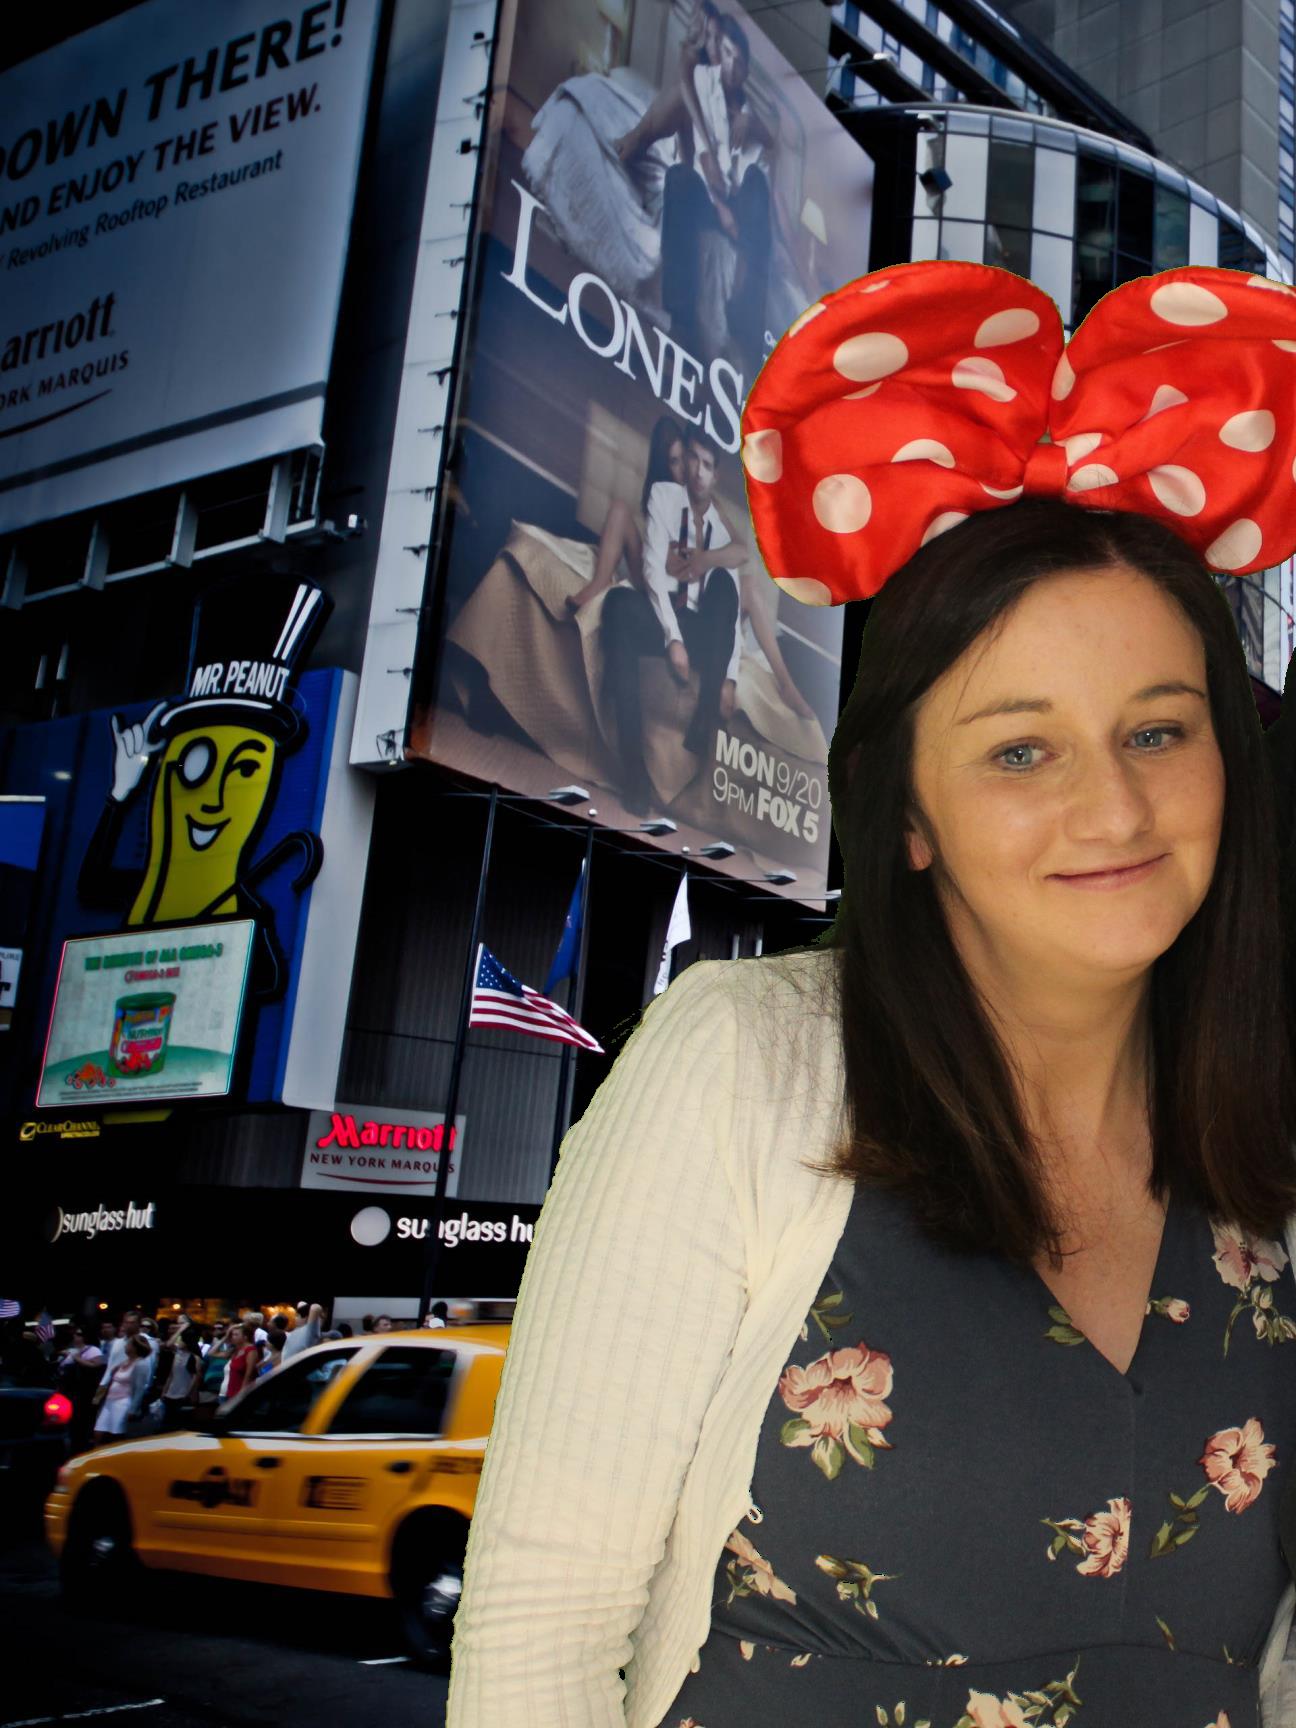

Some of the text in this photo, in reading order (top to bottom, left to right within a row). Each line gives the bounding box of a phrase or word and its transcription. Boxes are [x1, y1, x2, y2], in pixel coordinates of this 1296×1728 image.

[0, 0, 347, 182] OWN THERE!
[48, 150, 145, 216] ENJOY
[154, 122, 218, 172] THE
[229, 83, 322, 143] VIEW.
[8, 150, 283, 270] Revolving Rooftop Restaurant
[38, 350, 129, 397] MARQUIS
[189, 660, 291, 701] MR. PEANUT
[716, 729, 821, 810] MON 9/20
[713, 767, 820, 844] 9PM FOX 5
[310, 1152, 455, 1174] NEW YORK MARQUS
[316, 1113, 457, 1152] Marriott
[62, 1201, 154, 1240] sunglass hut
